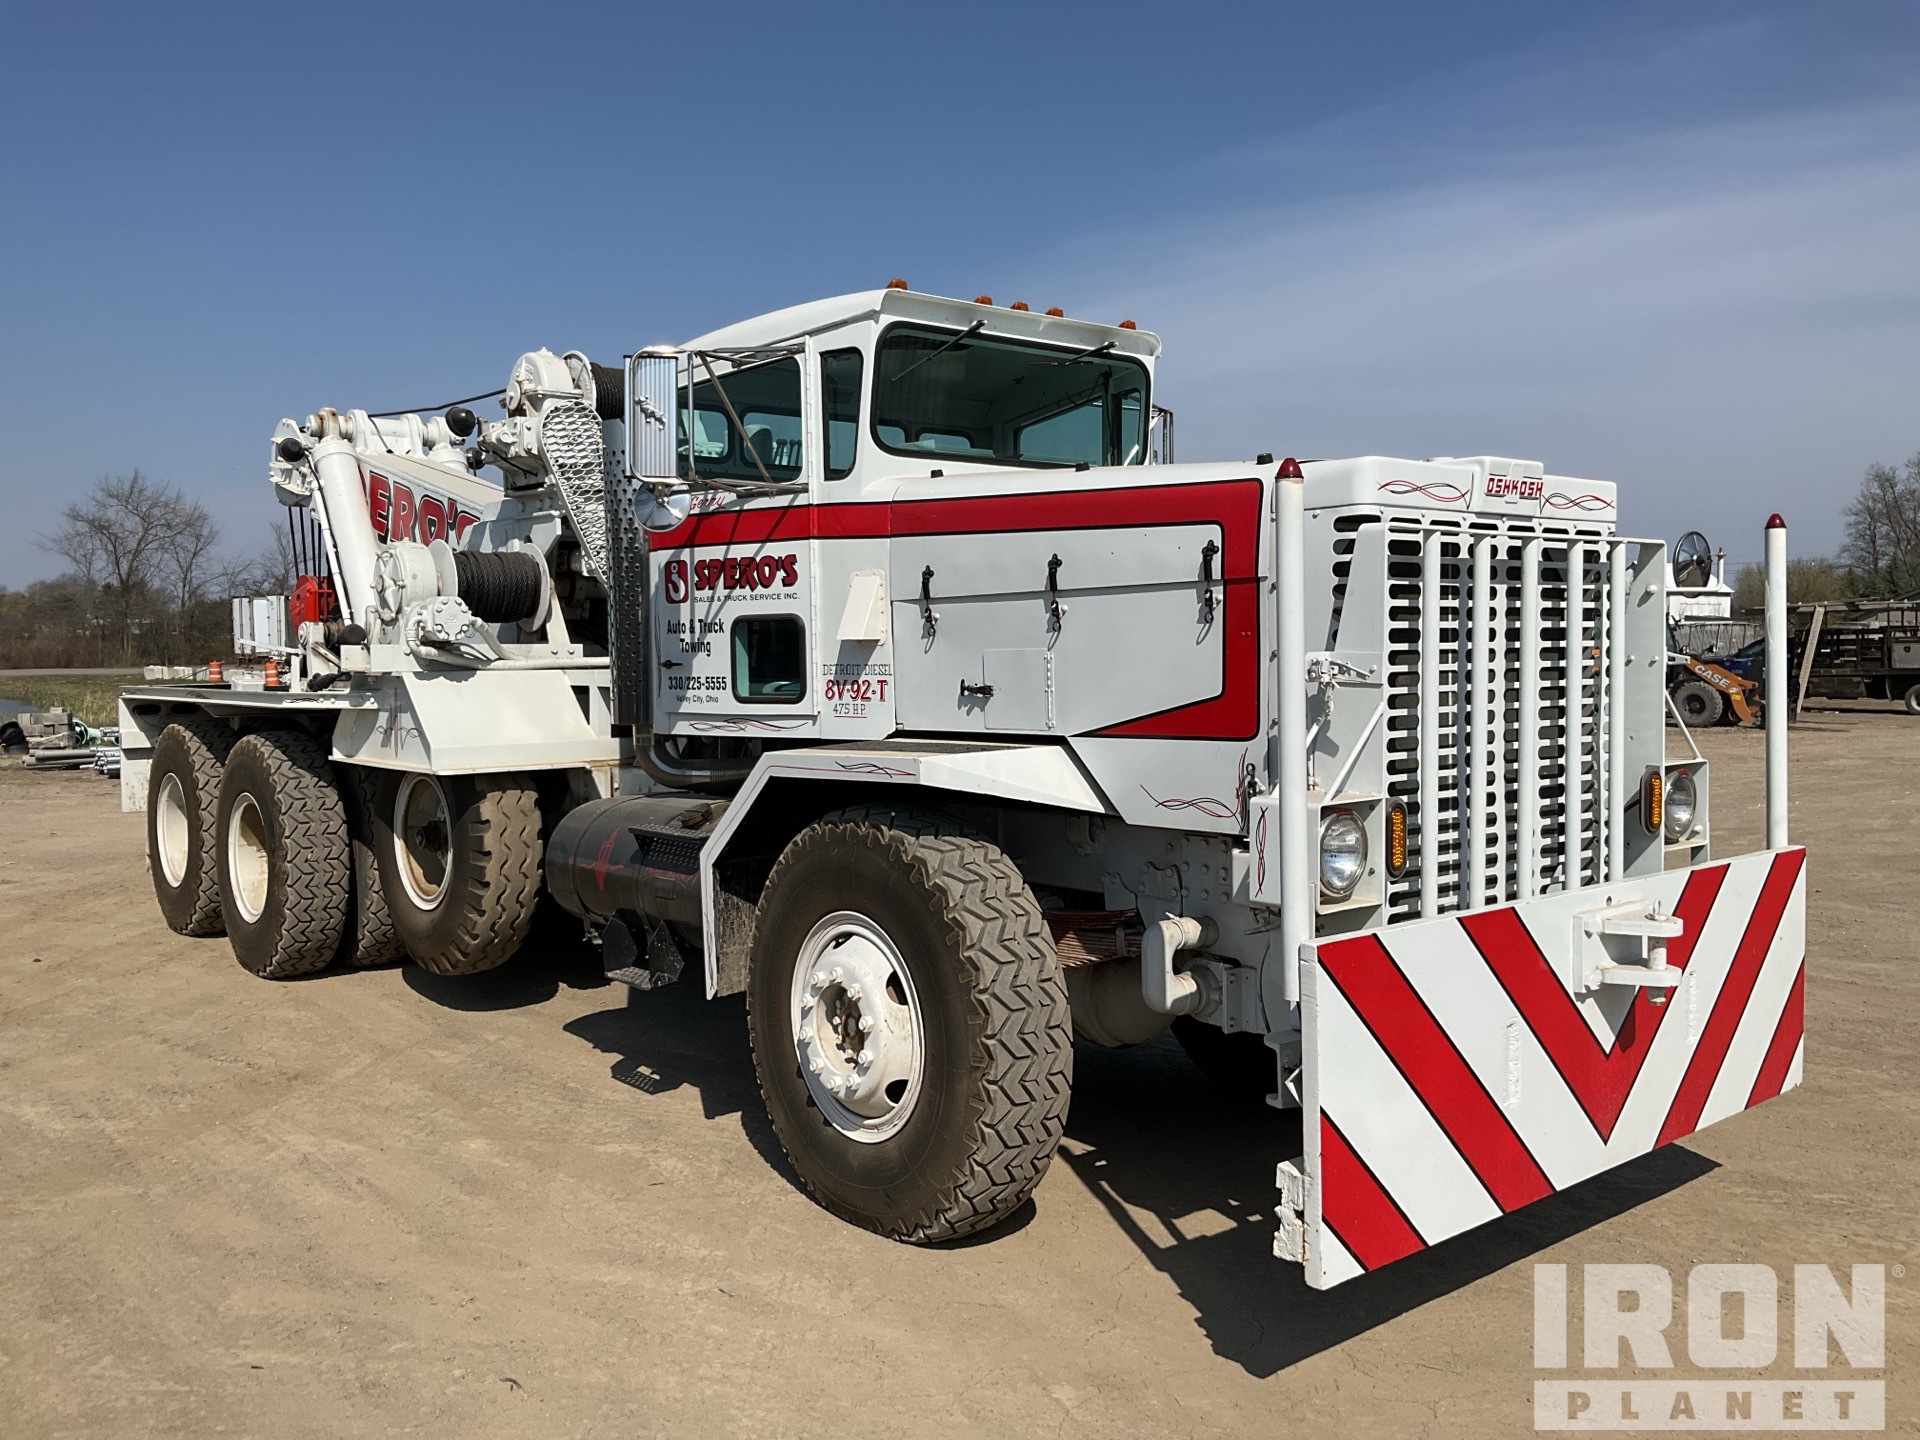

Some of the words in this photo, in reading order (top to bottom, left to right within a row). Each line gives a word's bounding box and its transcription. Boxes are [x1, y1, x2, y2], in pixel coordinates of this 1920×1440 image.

[1486, 477, 1543, 497] OSHKOSH
[694, 554, 798, 592] SPERO'S
[694, 595, 715, 603] SALES
[723, 594, 748, 602] TRUCK
[749, 592, 782, 601] SERVICE
[784, 592, 800, 600] INC.
[667, 619, 687, 634] Auto
[689, 618, 696, 634] &
[698, 618, 725, 634] Truck
[680, 637, 711, 657] Towing
[822, 663, 862, 676] DETROIT
[864, 664, 893, 676] DIESEL
[1694, 665, 1731, 688] CASE
[668, 676, 727, 691] 330/225-5555
[676, 694, 691, 704] Valley
[705, 694, 719, 703] Ohio
[833, 703, 851, 715] 475
